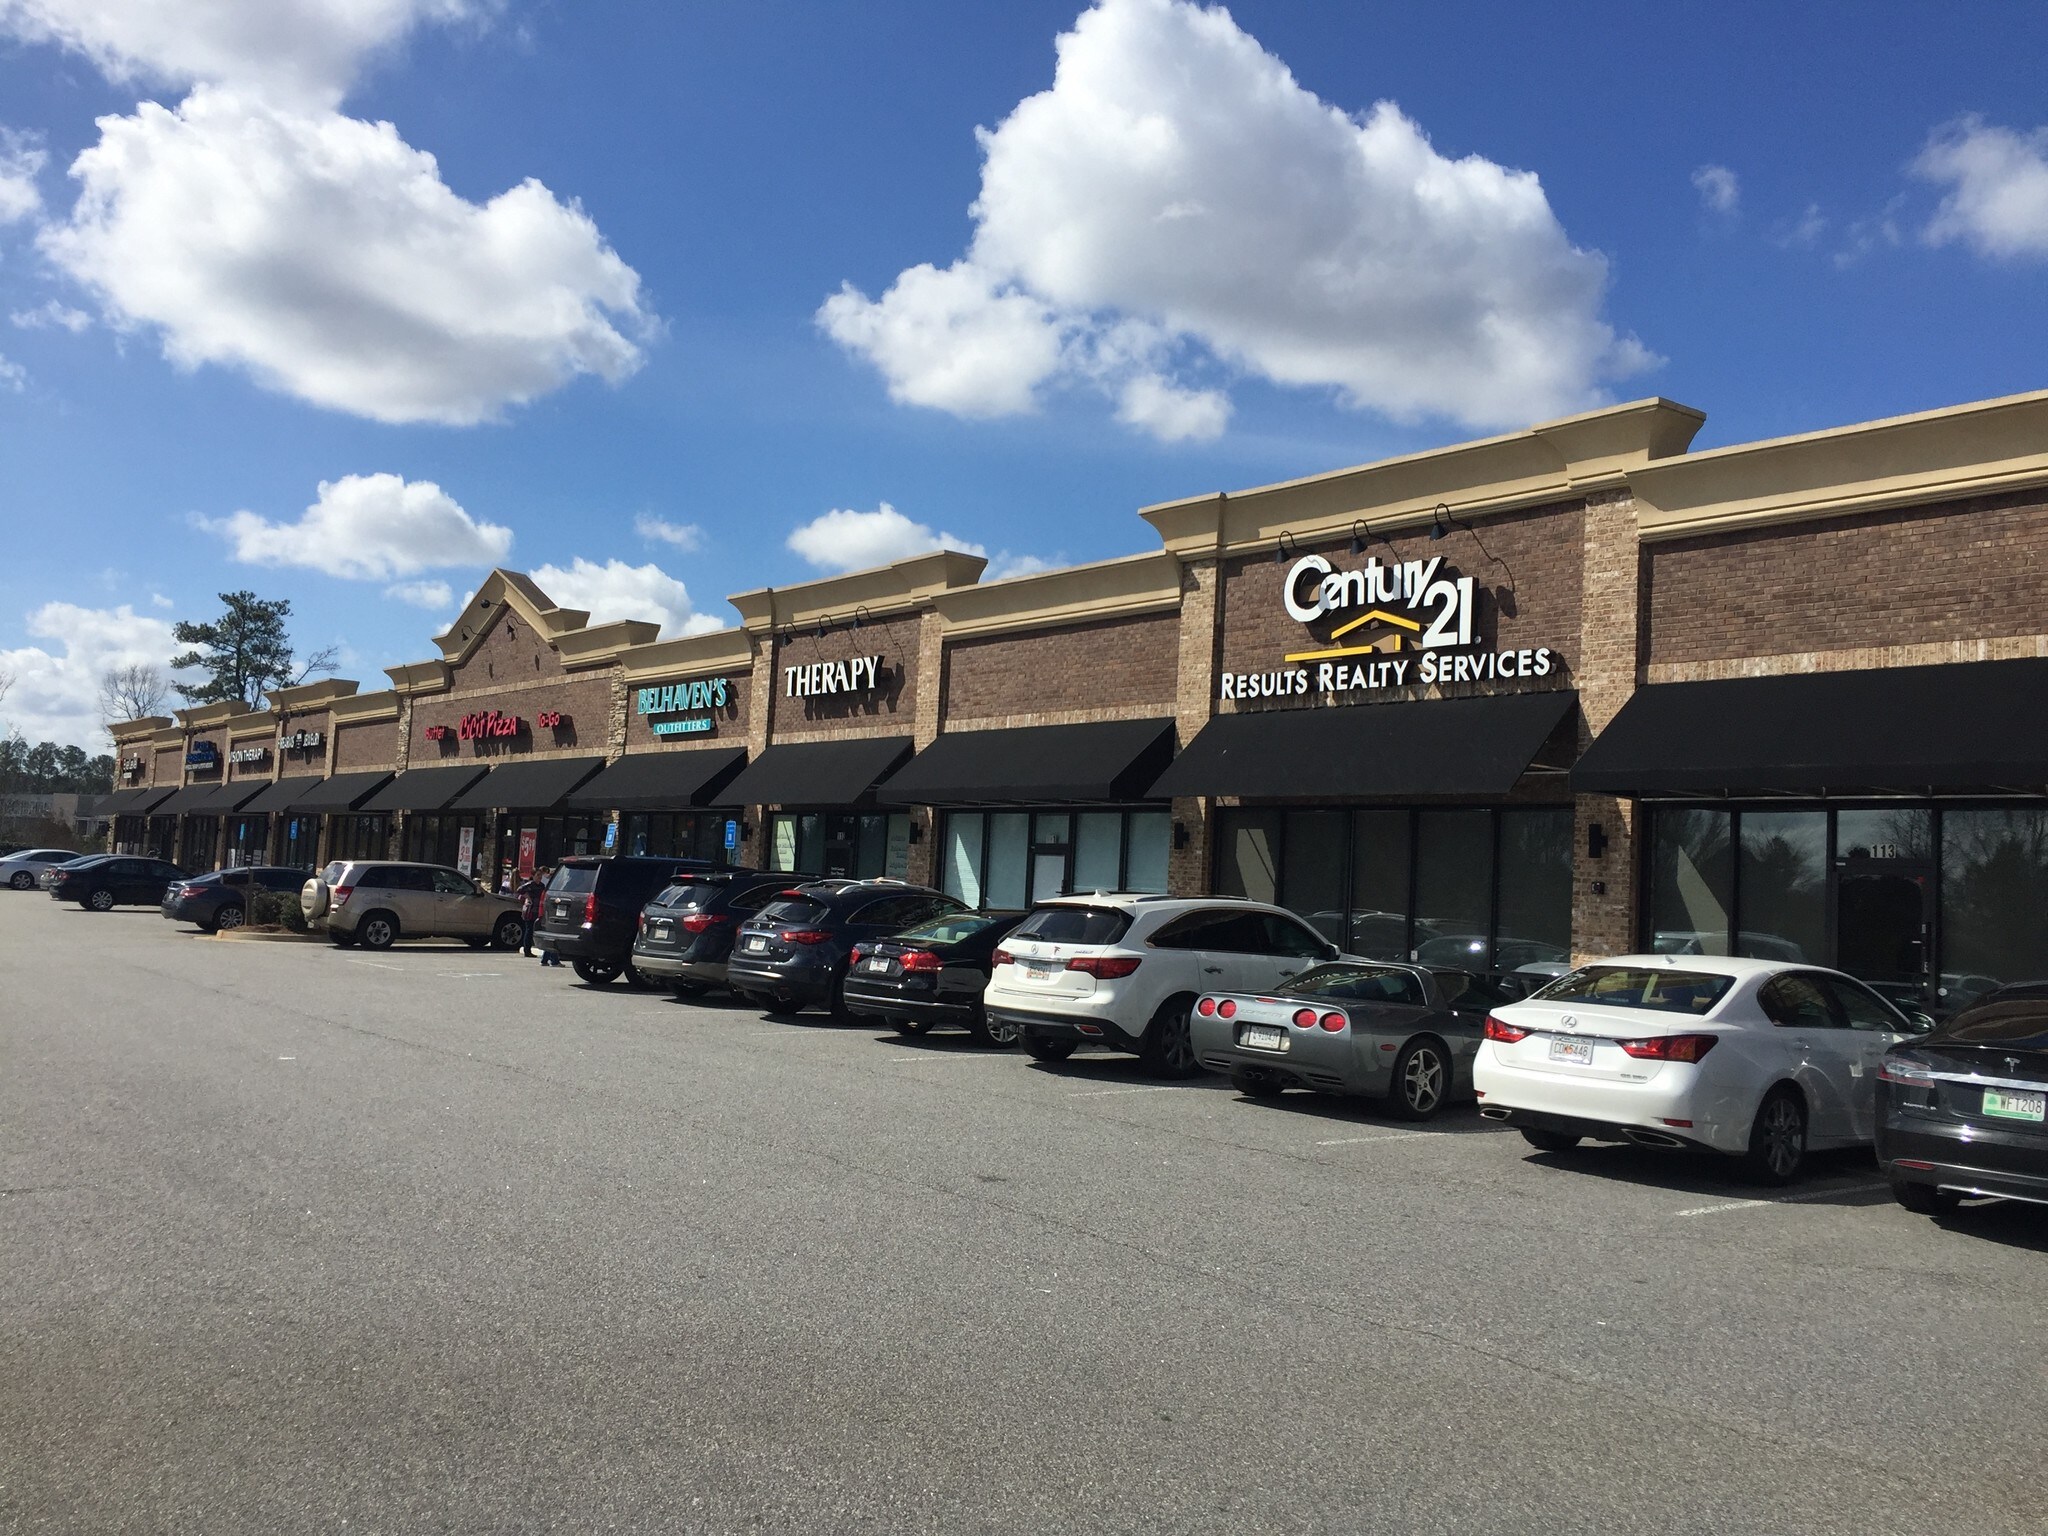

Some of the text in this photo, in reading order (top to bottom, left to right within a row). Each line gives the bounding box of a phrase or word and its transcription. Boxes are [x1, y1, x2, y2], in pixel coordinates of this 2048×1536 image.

[1283, 554, 1474, 648] Century 21
[785, 654, 881, 698] THERAPY
[1220, 647, 1551, 700] RESULTS REALTY SERVICES
[637, 677, 727, 715] BELHAVEN'S
[656, 719, 707, 733] OUTFITTERS
[243, 747, 264, 761] THERAPY
[1872, 844, 1895, 858] 113
[2000, 1096, 2043, 1114] WFT208
